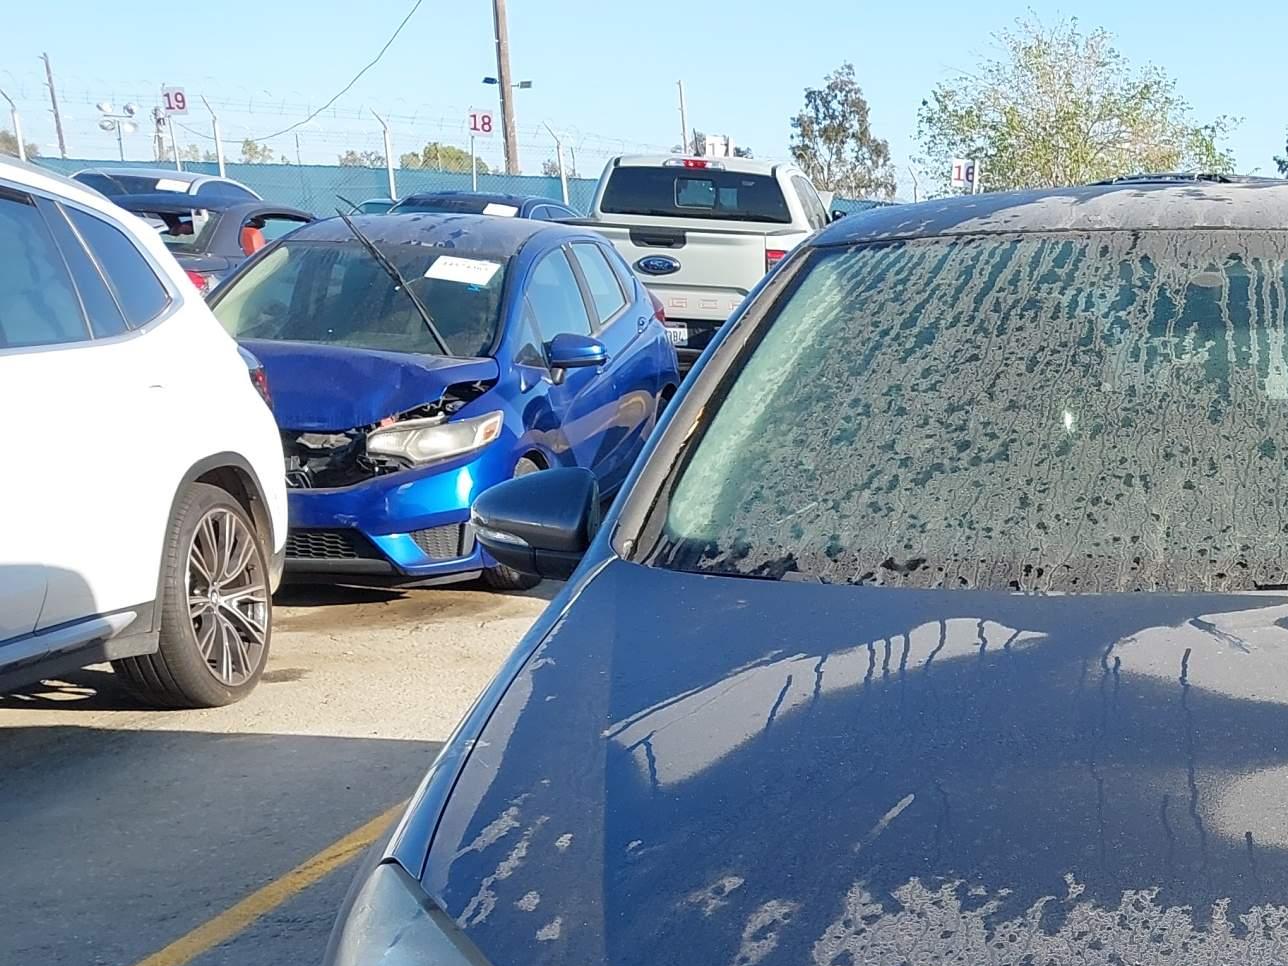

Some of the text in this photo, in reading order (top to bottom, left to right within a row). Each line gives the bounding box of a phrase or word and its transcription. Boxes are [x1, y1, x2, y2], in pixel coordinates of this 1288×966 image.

[163, 92, 186, 110] 19
[469, 114, 492, 132] 18
[953, 164, 975, 182] 16
